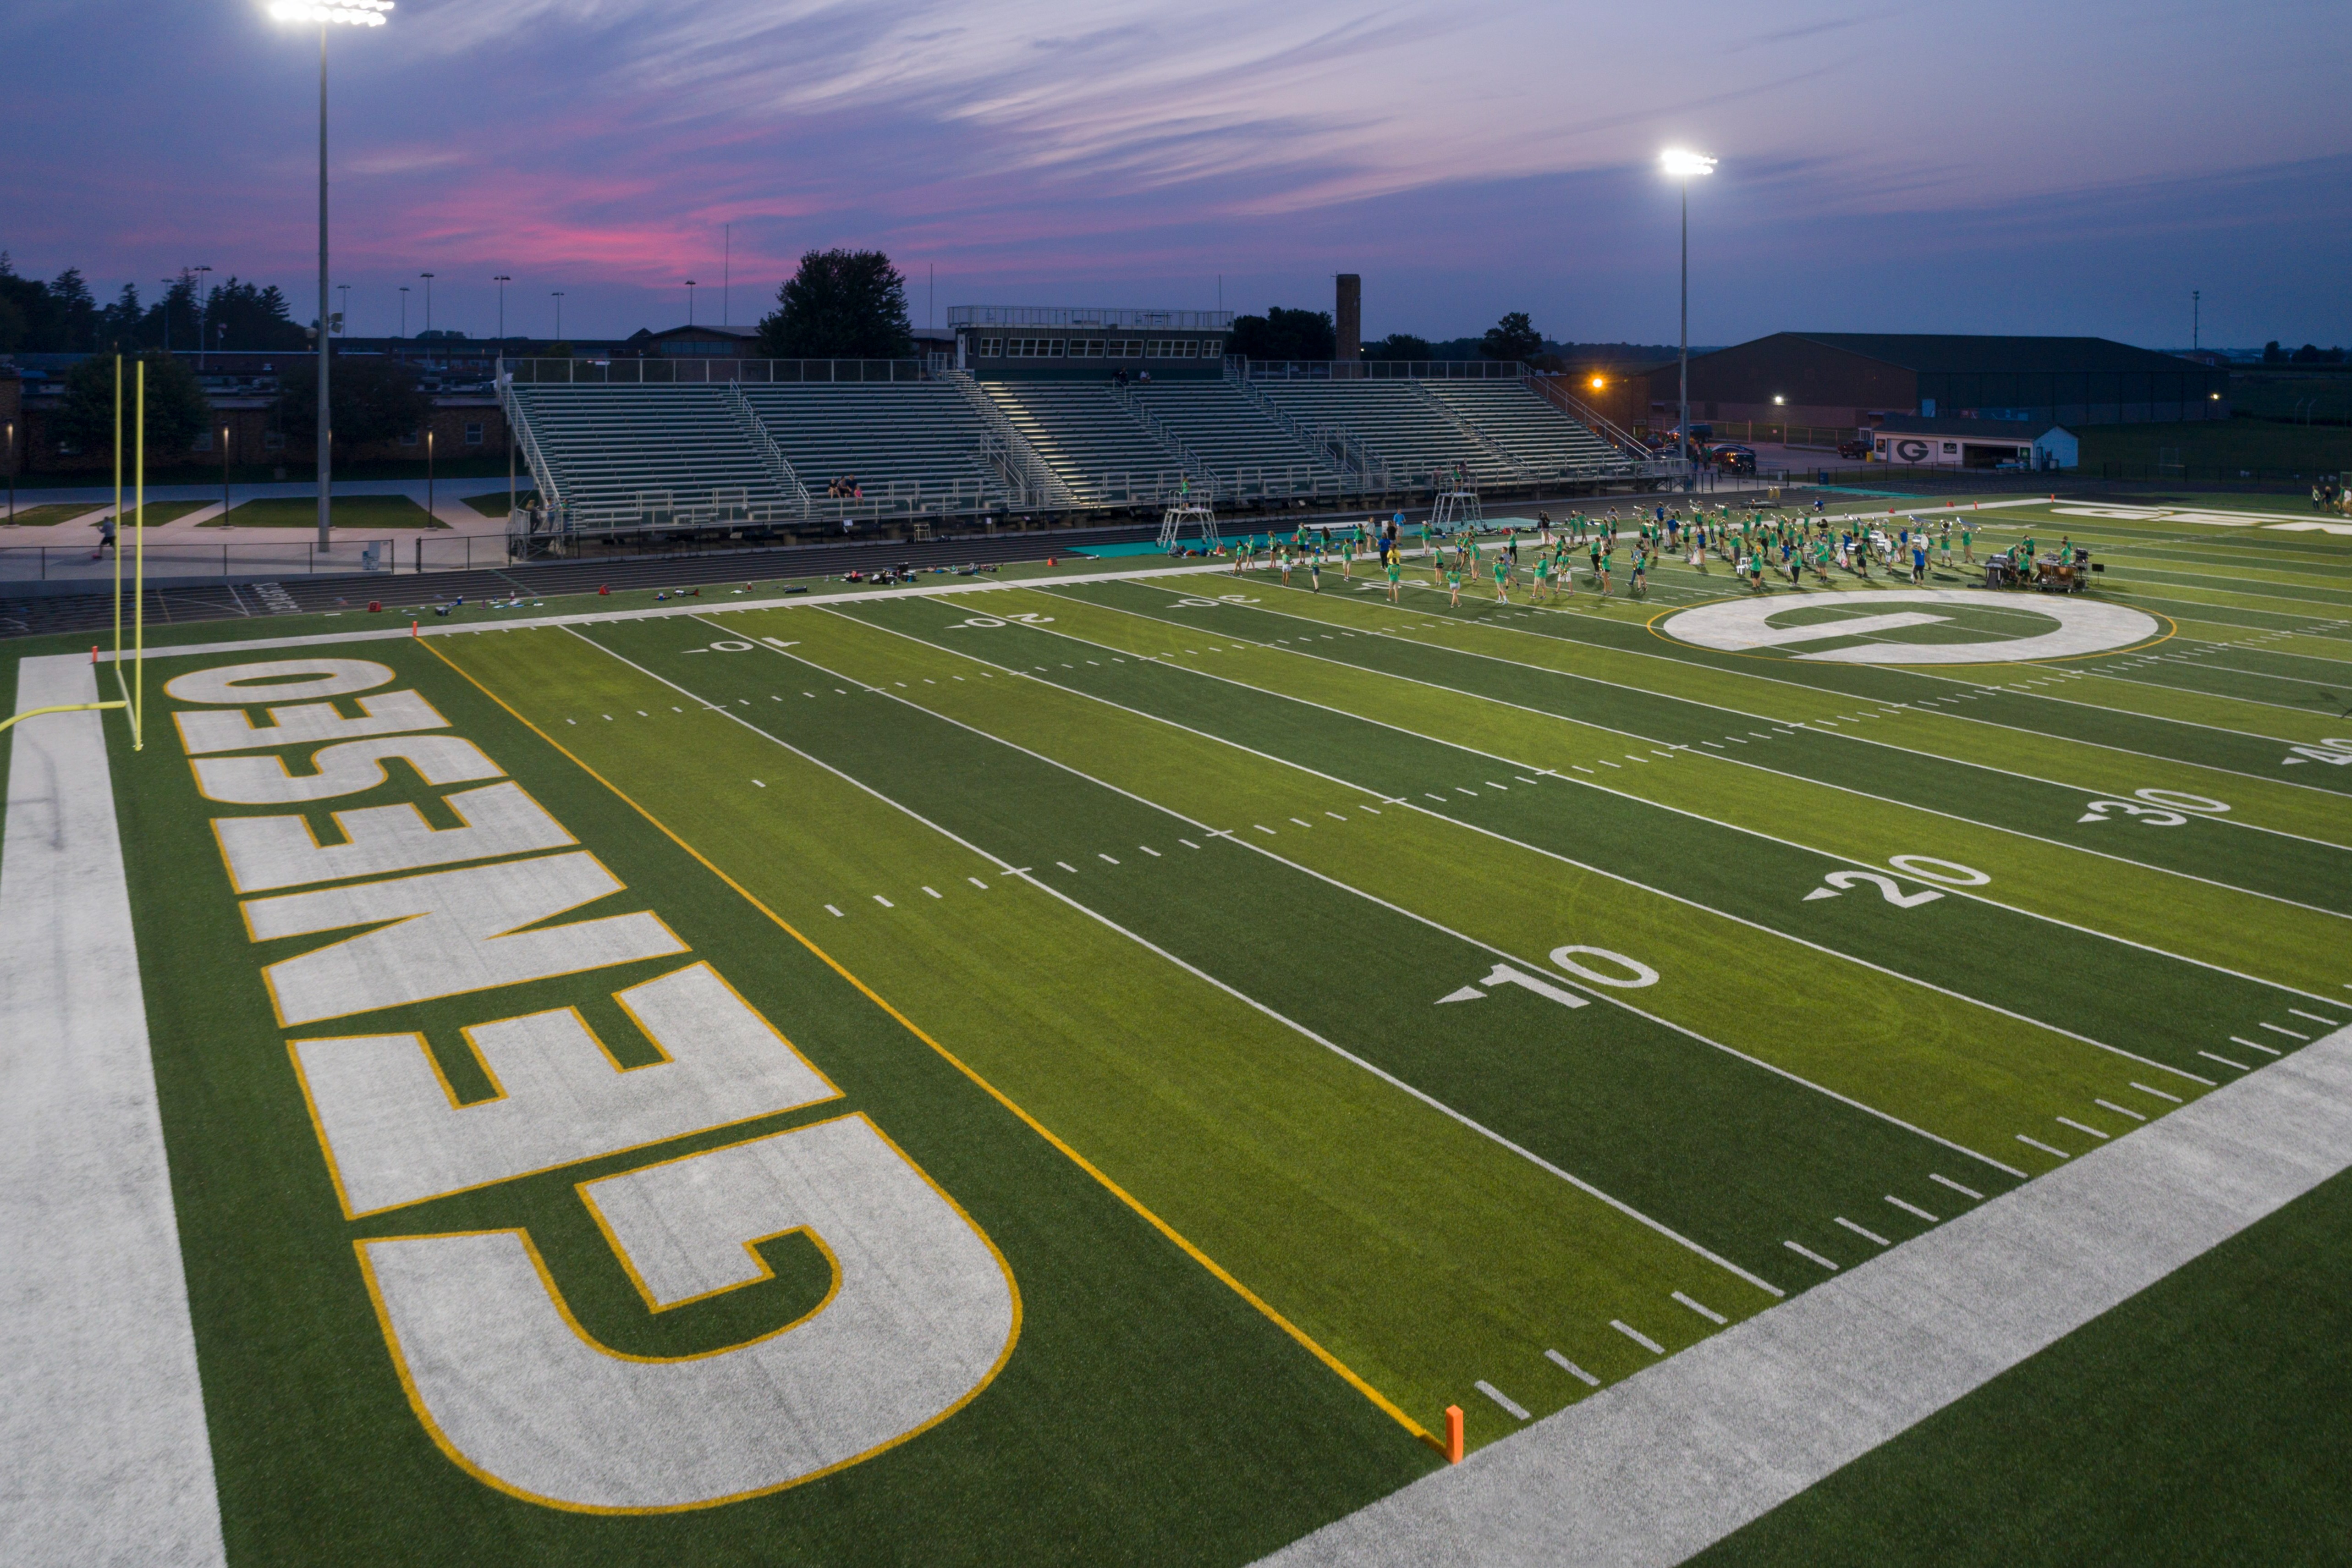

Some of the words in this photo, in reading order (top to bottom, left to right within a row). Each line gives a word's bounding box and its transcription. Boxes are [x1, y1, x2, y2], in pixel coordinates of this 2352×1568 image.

[1896, 440, 1929, 462] G
[963, 613, 1055, 628] 20
[1178, 594, 1261, 607] 30
[709, 637, 801, 652] 10
[1664, 589, 2160, 664] G
[2087, 787, 2231, 827] 30
[1824, 854, 1992, 908] 20
[1478, 944, 1660, 1009] 10
[164, 658, 1023, 1516] GENESEO
